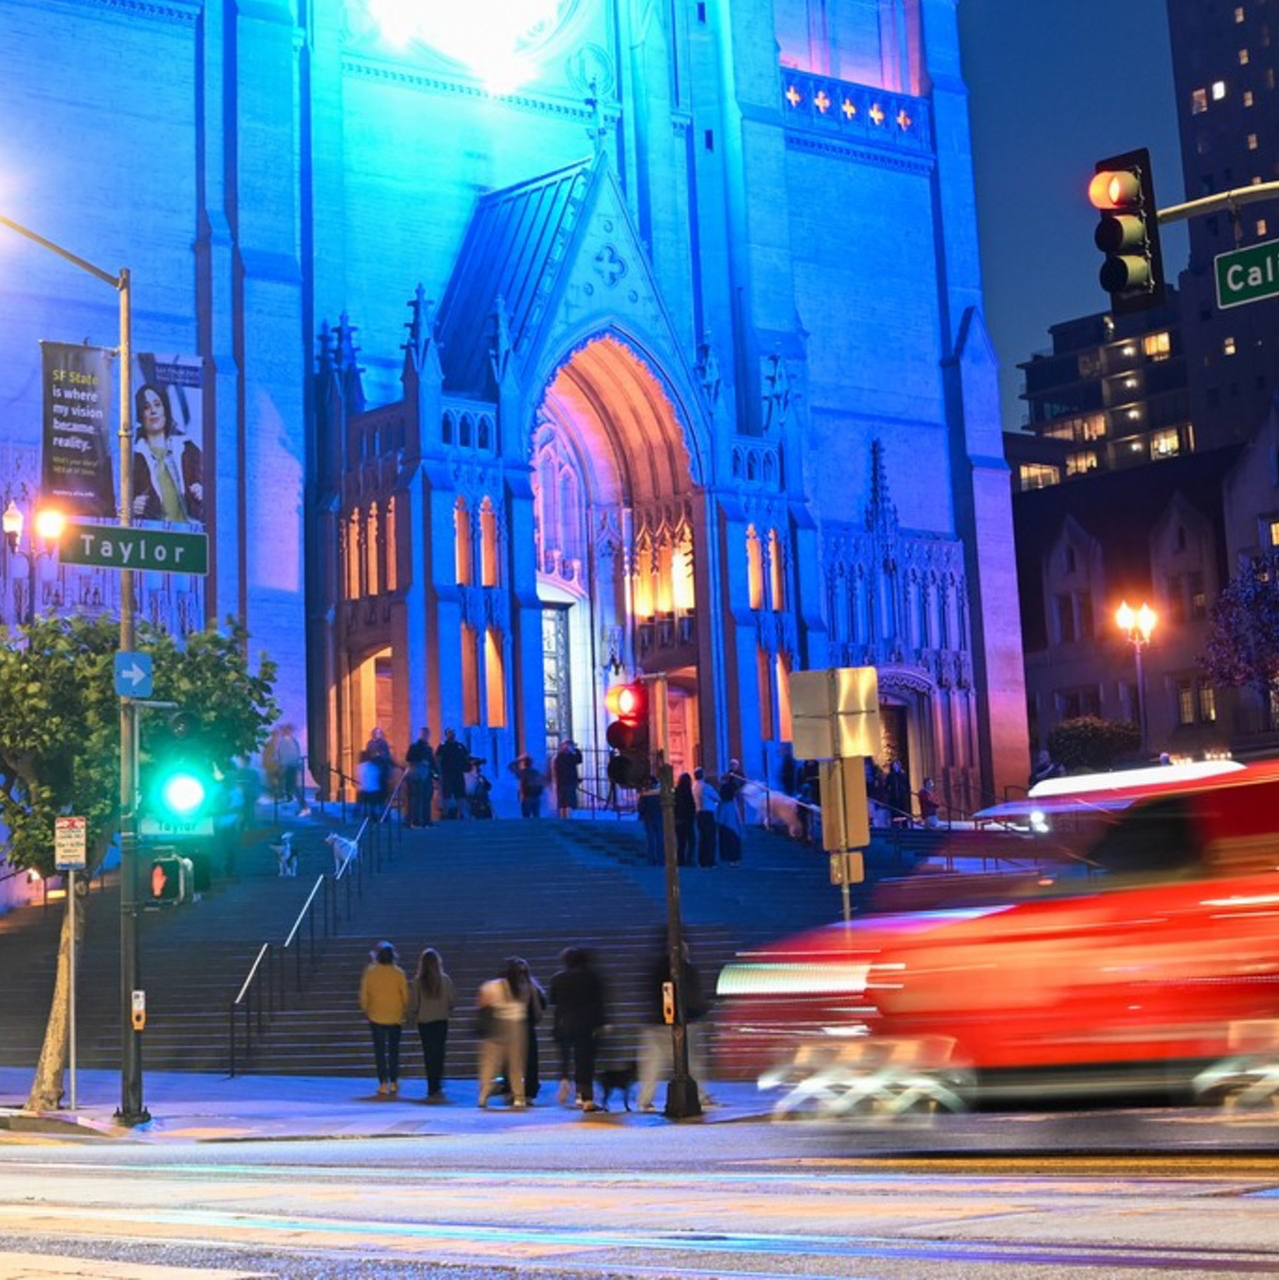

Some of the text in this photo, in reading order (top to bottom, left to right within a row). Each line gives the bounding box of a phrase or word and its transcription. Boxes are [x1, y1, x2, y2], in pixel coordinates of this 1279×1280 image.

[53, 369, 99, 385] SF State
[53, 384, 98, 402] is where
[53, 404, 103, 418] my vision
[53, 418, 95, 434] became
[81, 534, 184, 562] Taylor
[157, 820, 198, 834] Taylor
